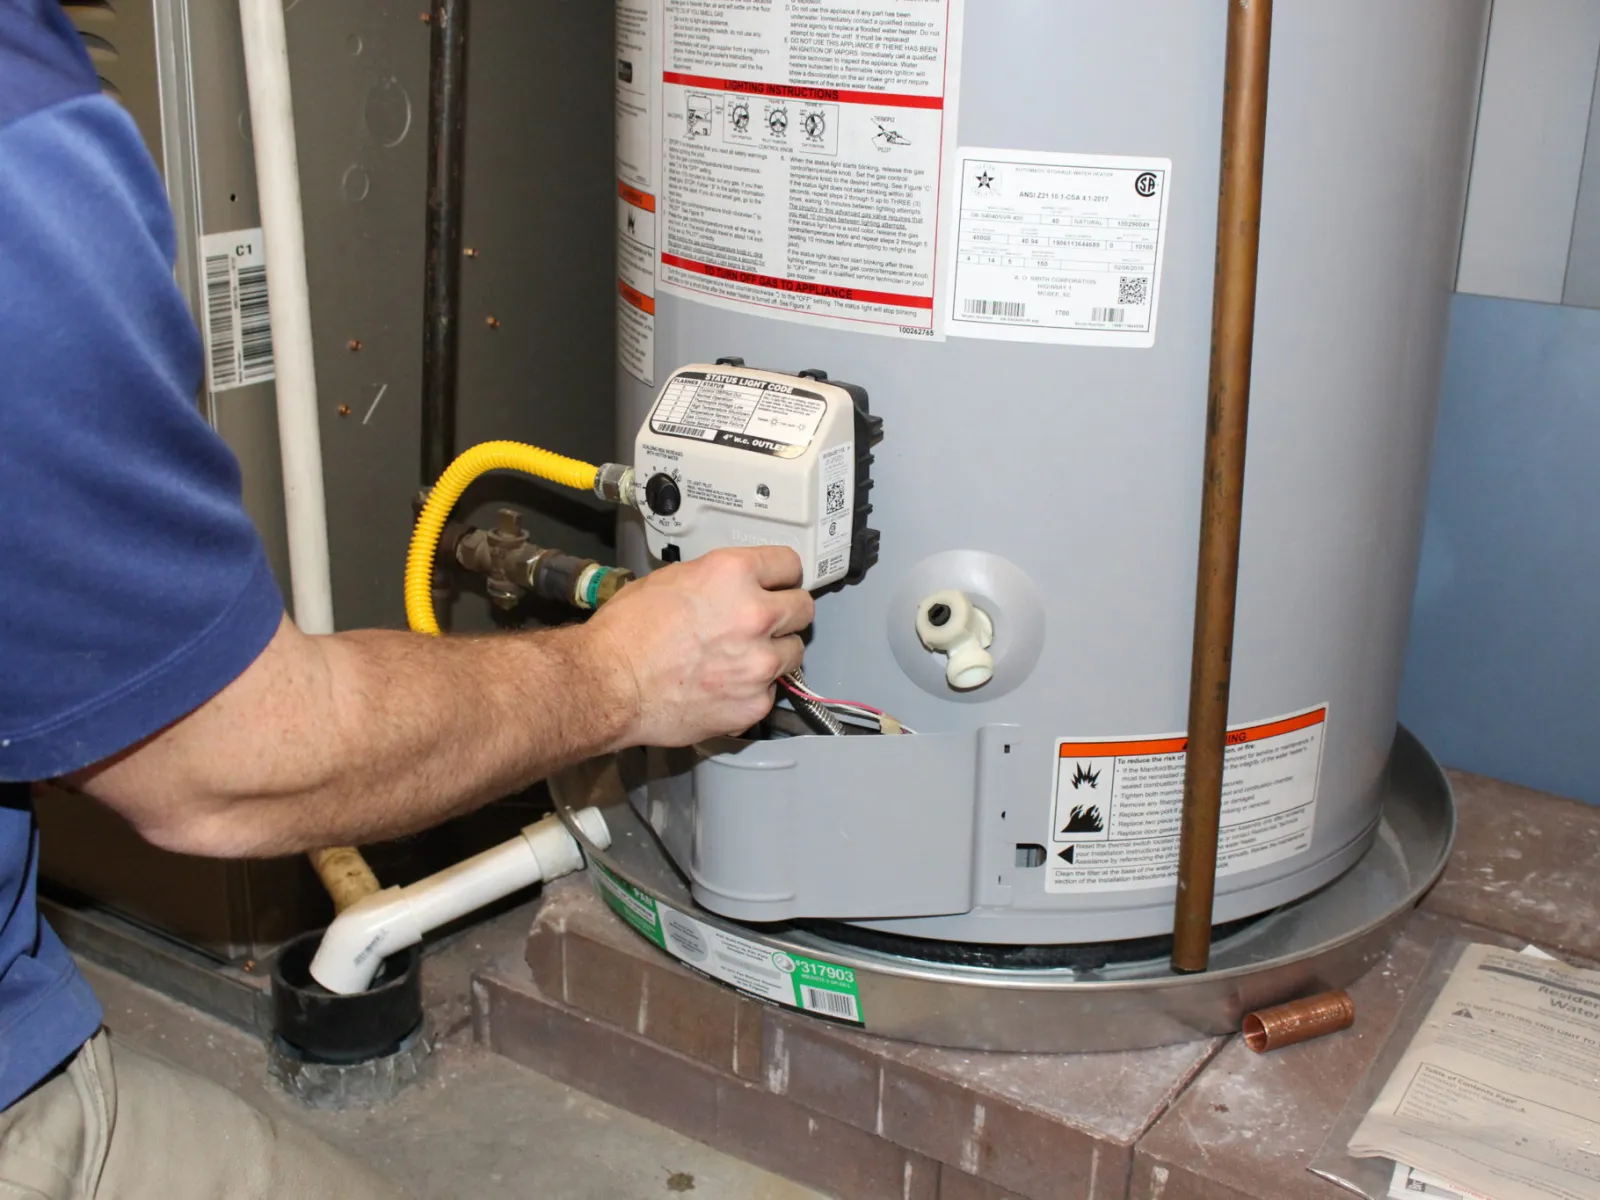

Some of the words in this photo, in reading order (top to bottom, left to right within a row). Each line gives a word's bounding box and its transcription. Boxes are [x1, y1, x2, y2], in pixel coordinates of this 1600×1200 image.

[829, 7, 855, 16] appliance
[871, 9, 883, 17] part
[896, 10, 911, 18] been
[840, 40, 873, 48] APPLIANCE
[881, 42, 903, 50] THERE
[724, 80, 765, 92] LIGHTING
[766, 84, 839, 100] INSTRUCTIONS
[790, 155, 804, 163] When
[830, 159, 841, 168] light
[842, 160, 857, 168] starts
[881, 164, 902, 172] release
[913, 168, 924, 176] gas
[236, 244, 252, 256] C1
[800, 250, 814, 258] status
[815, 252, 826, 260] light
[863, 257, 884, 267] blinking
[898, 261, 913, 269] three
[705, 265, 714, 275] TO
[718, 267, 737, 279] TURN
[740, 271, 756, 282] OFF
[761, 274, 778, 286] GAS
[781, 281, 793, 290] TO
[795, 283, 853, 299] APPLIANCE
[1051, 277, 1096, 285] CORPORATION
[845, 302, 860, 310] status
[861, 304, 872, 312] light
[896, 309, 917, 317] blinking
[899, 327, 934, 336] 100262765
[702, 381, 725, 389] STATUS
[705, 374, 737, 384] STATUS
[739, 378, 766, 389] LIGHT
[767, 383, 794, 394] CODE
[712, 393, 733, 403] Operation
[722, 433, 733, 441] 4"
[1119, 809, 1144, 818] Replace
[1118, 819, 1143, 827] Replace
[1156, 817, 1173, 825] piece
[1090, 848, 1124, 856] Installation
[1125, 846, 1160, 854] Instructions
[1557, 1028, 1580, 1040] UNIT
